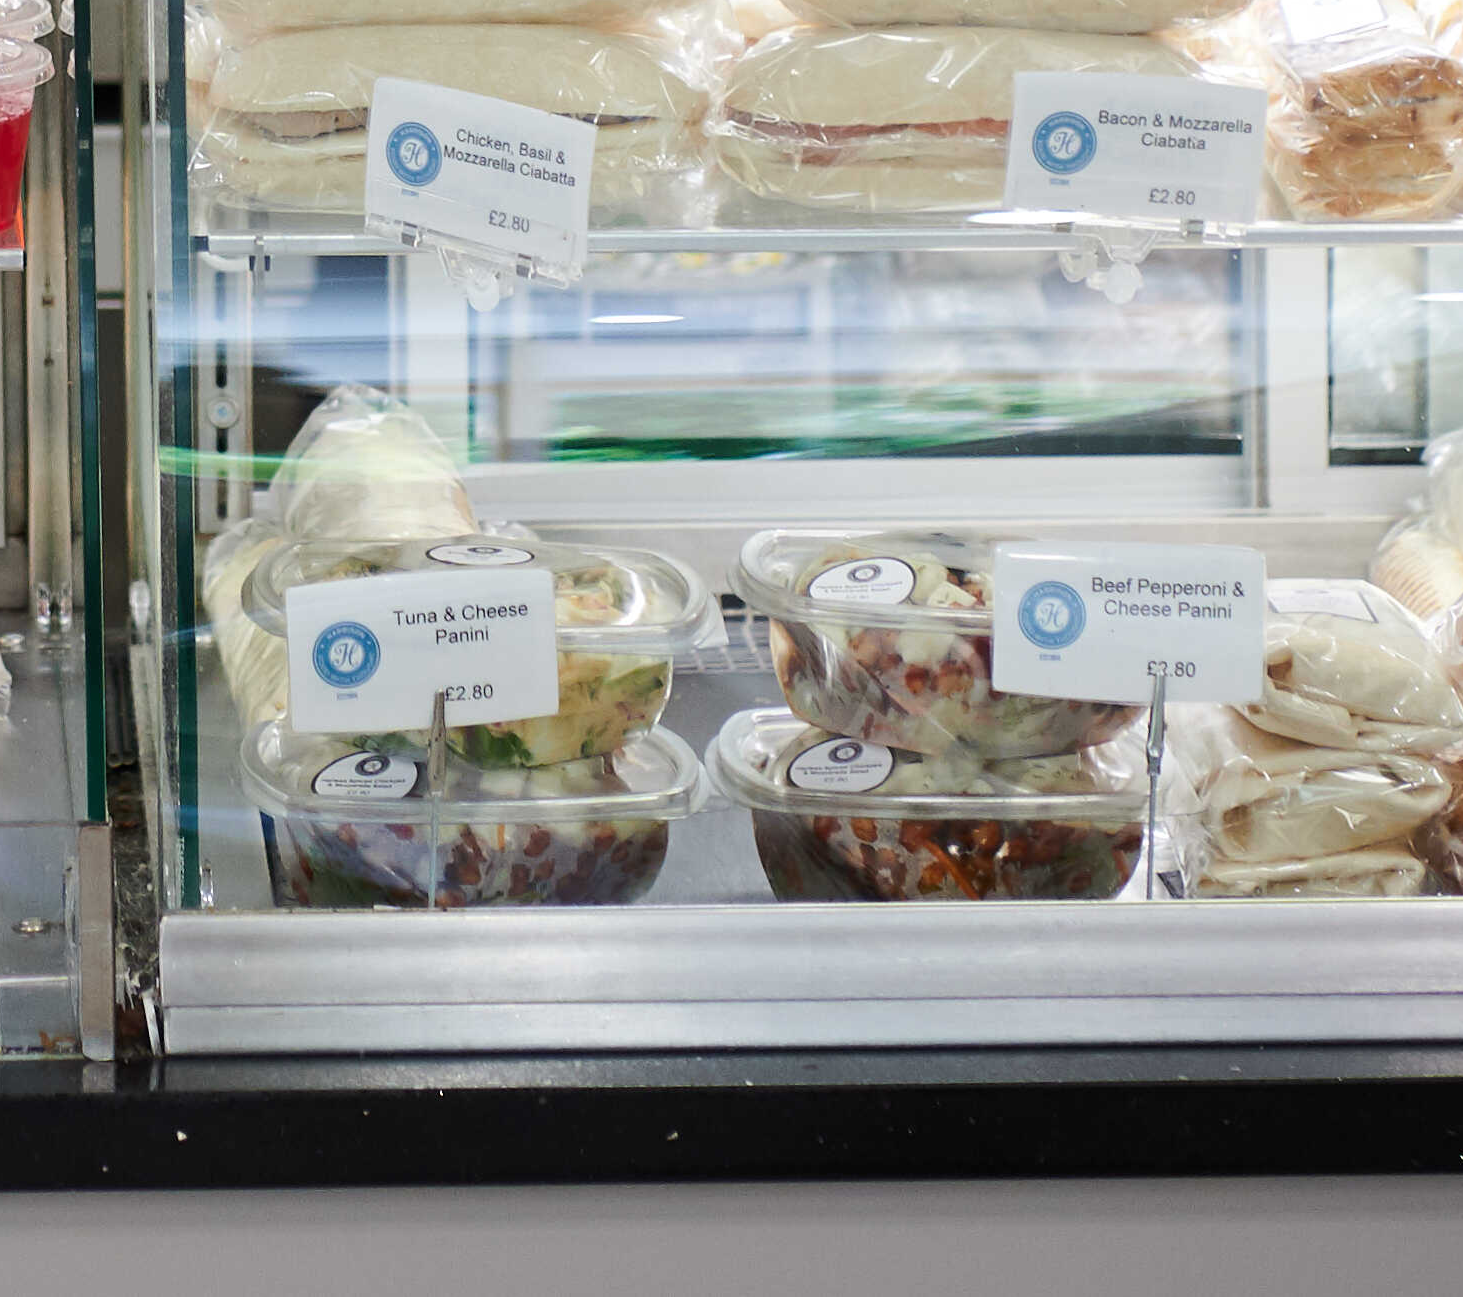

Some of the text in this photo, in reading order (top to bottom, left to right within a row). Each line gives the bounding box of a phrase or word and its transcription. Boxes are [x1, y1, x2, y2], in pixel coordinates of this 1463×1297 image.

[1099, 110, 1252, 133] Bacon & Mozzarella
[1141, 133, 1205, 150] Ciabatta
[444, 141, 575, 186] Mozzarella Ciabatta
[519, 142, 552, 161] Basil
[556, 151, 565, 165] &
[1148, 188, 1195, 205] £2.80
[489, 210, 529, 233] £2.80
[1092, 577, 1244, 598] Beef Pepperoni &
[393, 605, 528, 625] Tuna & Cheese
[1104, 599, 1231, 618] Cheese Panini
[436, 628, 488, 645] Panini
[445, 685, 494, 702] £2.80
